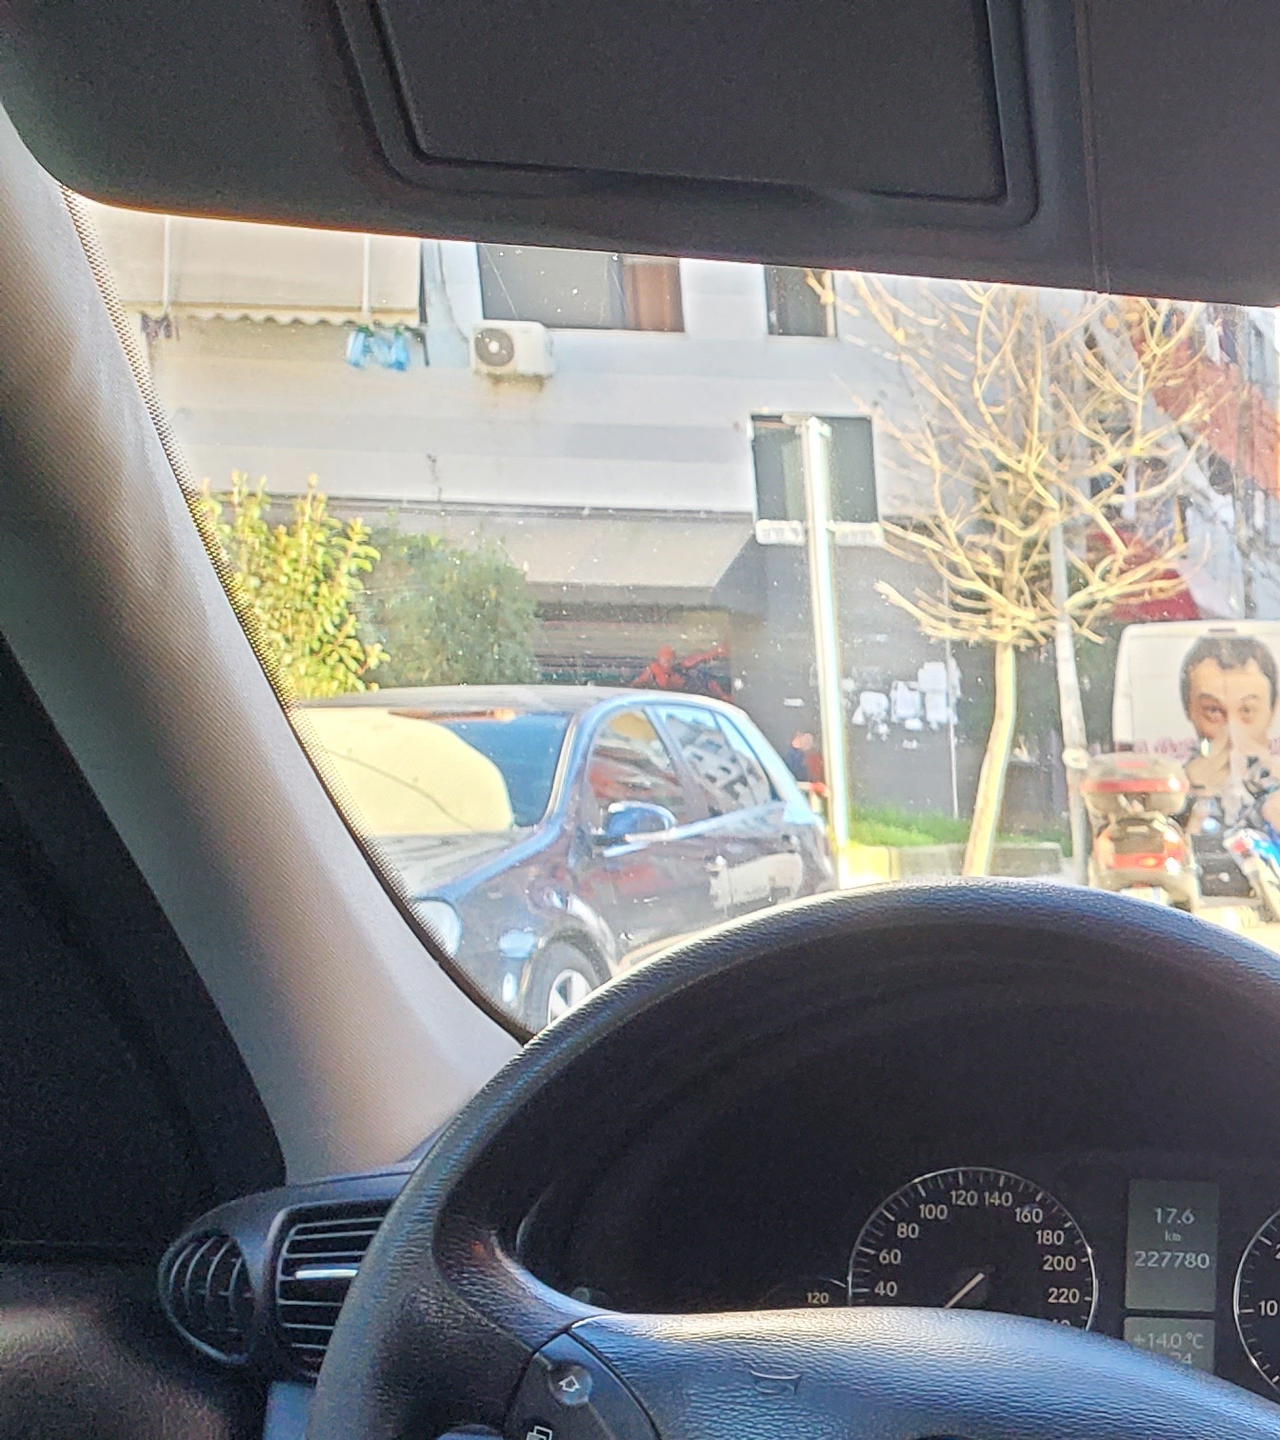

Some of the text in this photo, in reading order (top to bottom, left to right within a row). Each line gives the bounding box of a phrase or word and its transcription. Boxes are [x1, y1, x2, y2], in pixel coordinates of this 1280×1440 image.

[951, 1190, 978, 1206] 120
[984, 1191, 1013, 1207] 140
[919, 1204, 948, 1219] 100
[1015, 1207, 1043, 1223] 160
[1154, 1207, 1195, 1224] 17.6
[897, 1222, 919, 1238] 80
[1036, 1229, 1064, 1245] 180
[879, 1249, 901, 1265] 60
[1043, 1255, 1076, 1271] 200
[1134, 1251, 1210, 1269] 227780
[874, 1280, 898, 1296] 40
[1047, 1287, 1080, 1304] 220
[806, 1292, 829, 1304] 120
[1259, 1299, 1278, 1316] 10
